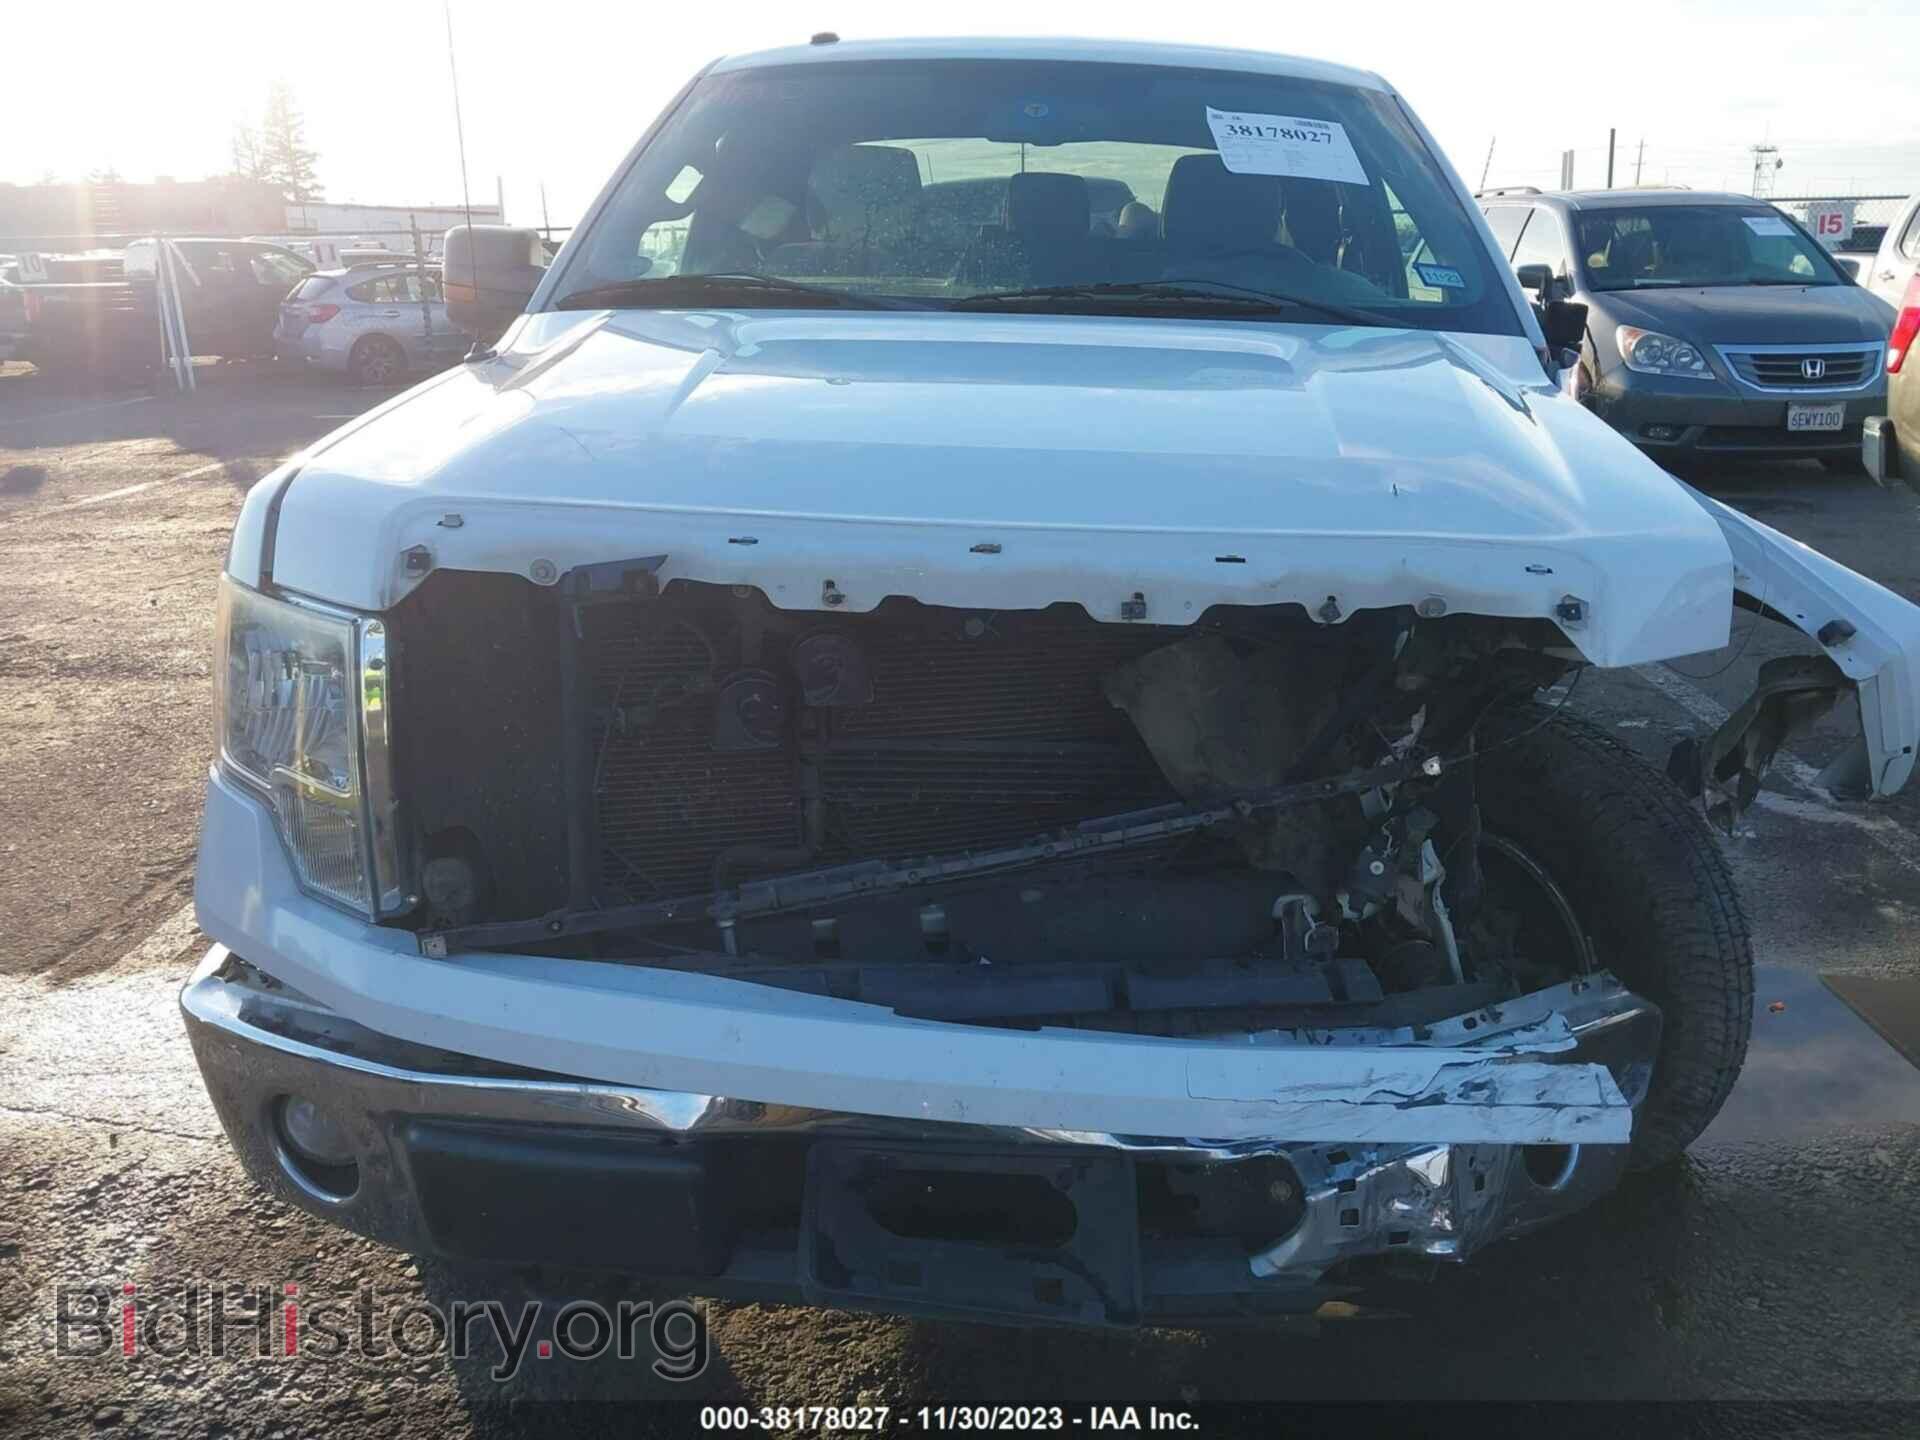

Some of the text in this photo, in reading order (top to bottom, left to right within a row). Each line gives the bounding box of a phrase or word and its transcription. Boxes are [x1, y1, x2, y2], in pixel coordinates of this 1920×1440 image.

[1226, 124, 1331, 144] 38178027
[1819, 214, 1843, 234] 15
[22, 254, 40, 272] 10
[1791, 411, 1840, 426] 6EWY100
